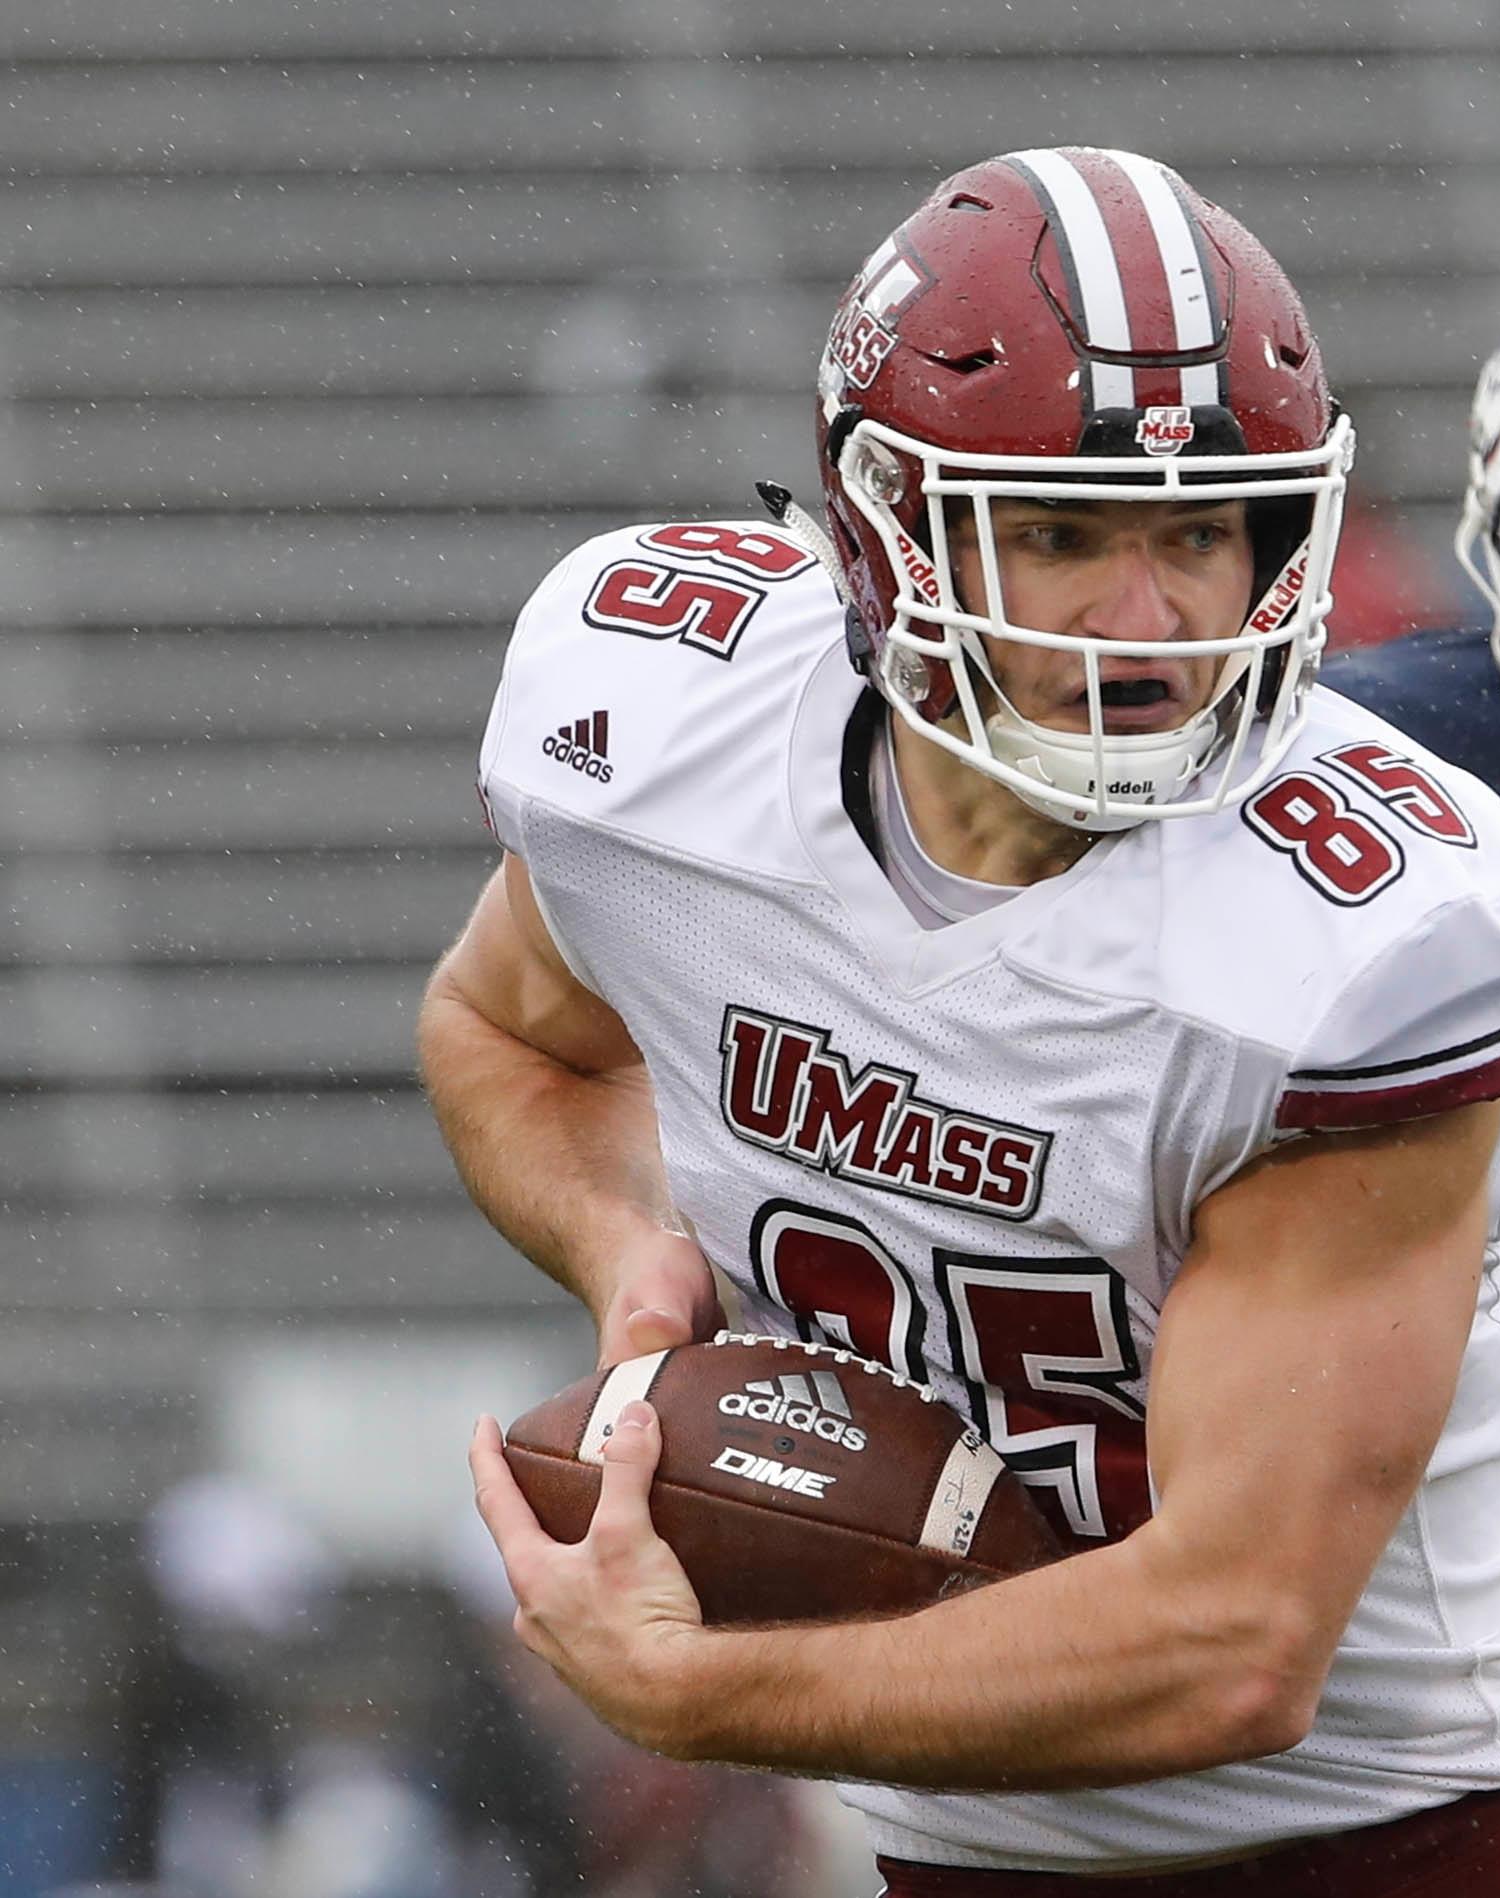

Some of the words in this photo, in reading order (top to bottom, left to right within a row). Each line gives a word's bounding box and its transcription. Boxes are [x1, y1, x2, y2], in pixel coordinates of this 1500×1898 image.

[583, 524, 818, 662] 85
[542, 735, 614, 784] adidas
[1088, 779, 1155, 794] Rddell
[1241, 741, 1478, 907] 85
[718, 1393, 868, 1452] adidas
[710, 1446, 837, 1499] DIME
